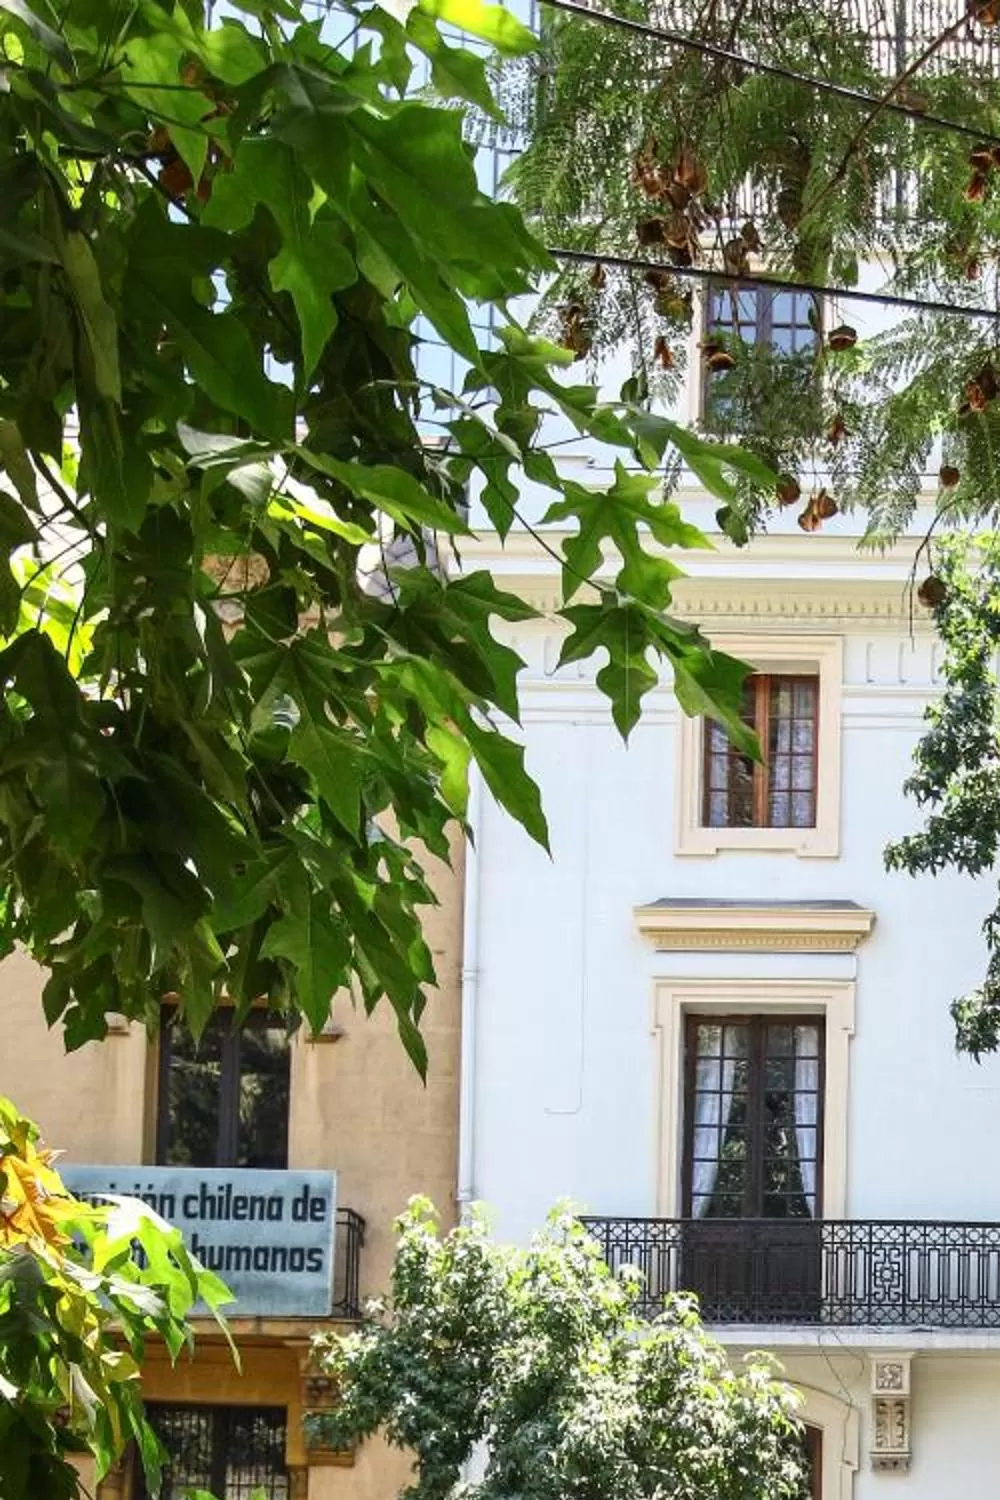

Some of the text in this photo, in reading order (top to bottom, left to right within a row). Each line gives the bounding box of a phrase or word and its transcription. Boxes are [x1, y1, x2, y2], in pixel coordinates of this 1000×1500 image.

[182, 1182, 283, 1222] chilena
[291, 1184, 326, 1222] de
[190, 1233, 323, 1274] humanos
